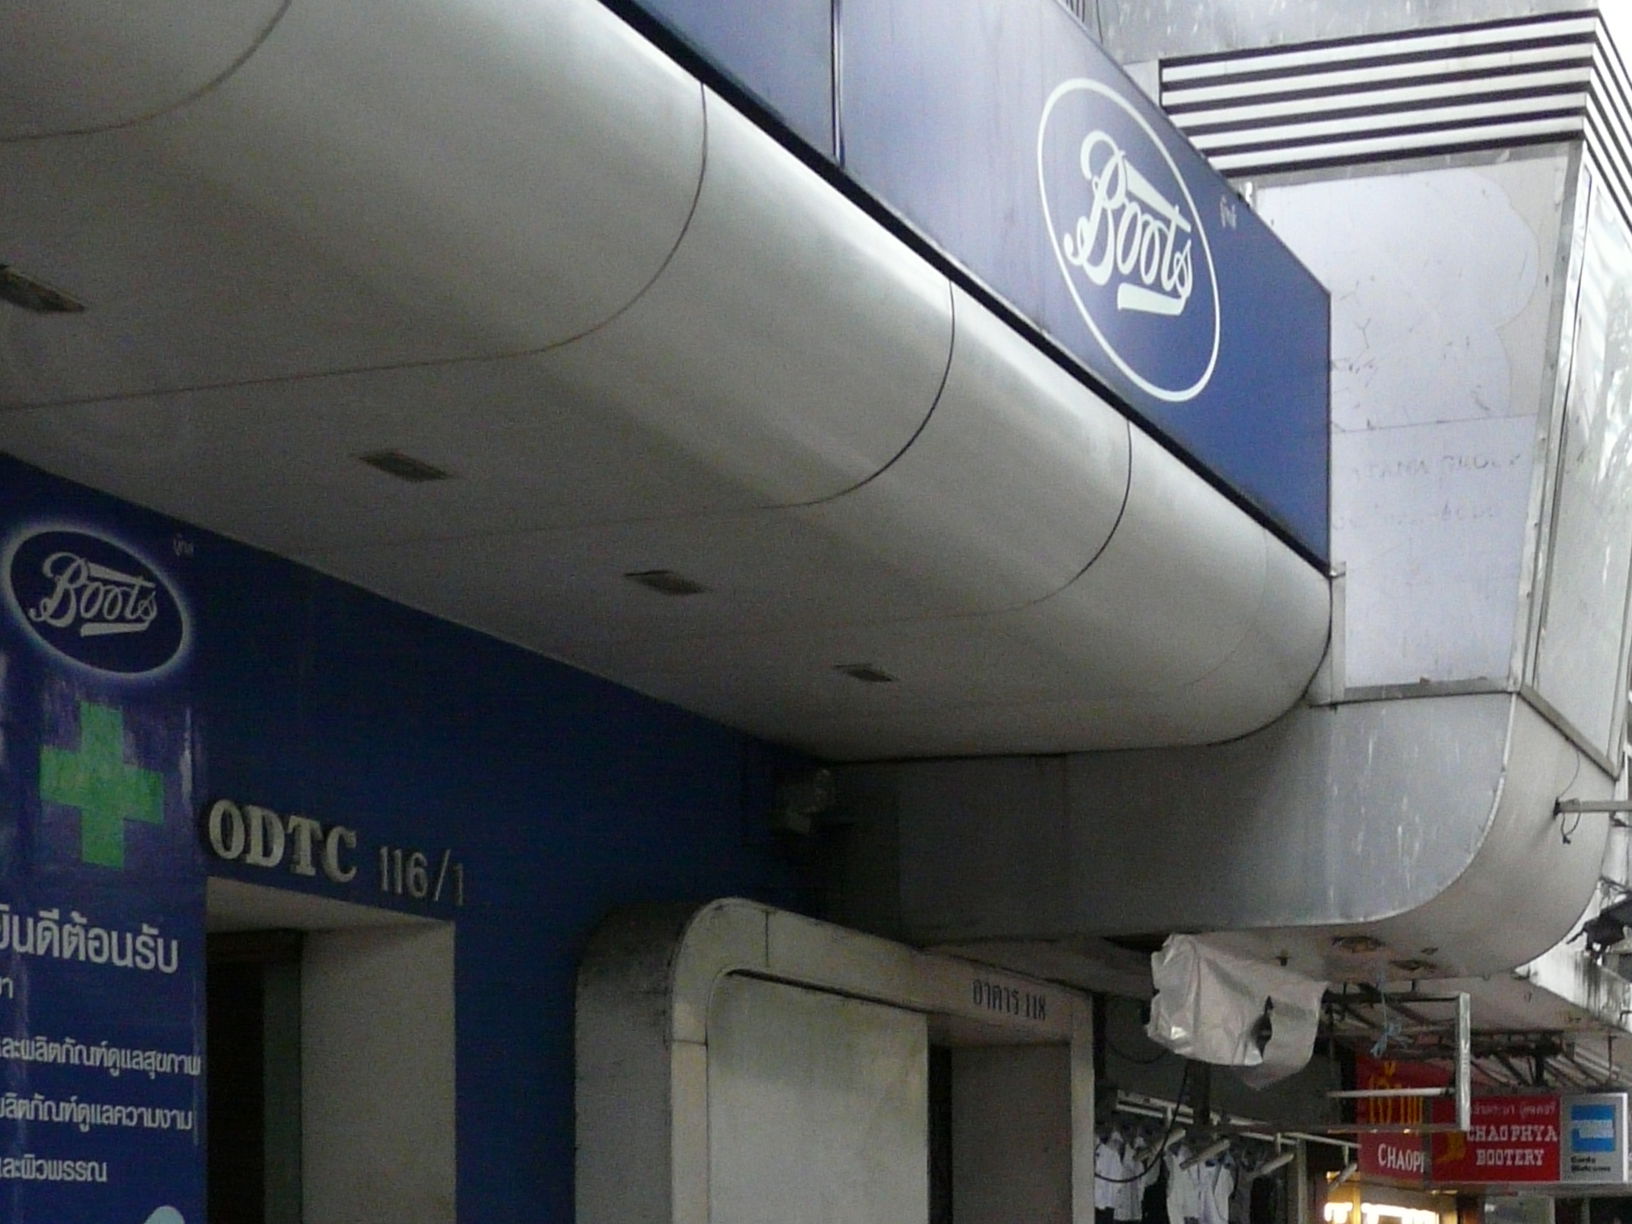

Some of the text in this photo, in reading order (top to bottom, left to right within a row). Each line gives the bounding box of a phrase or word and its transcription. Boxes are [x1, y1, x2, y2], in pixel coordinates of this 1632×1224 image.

[1064, 130, 1193, 316] Boots
[28, 552, 157, 637] Boots
[209, 800, 463, 906] ODTC 116/1
[973, 979, 1019, 1015] อาคาร
[1476, 1149, 1544, 1166] BOOTERY
